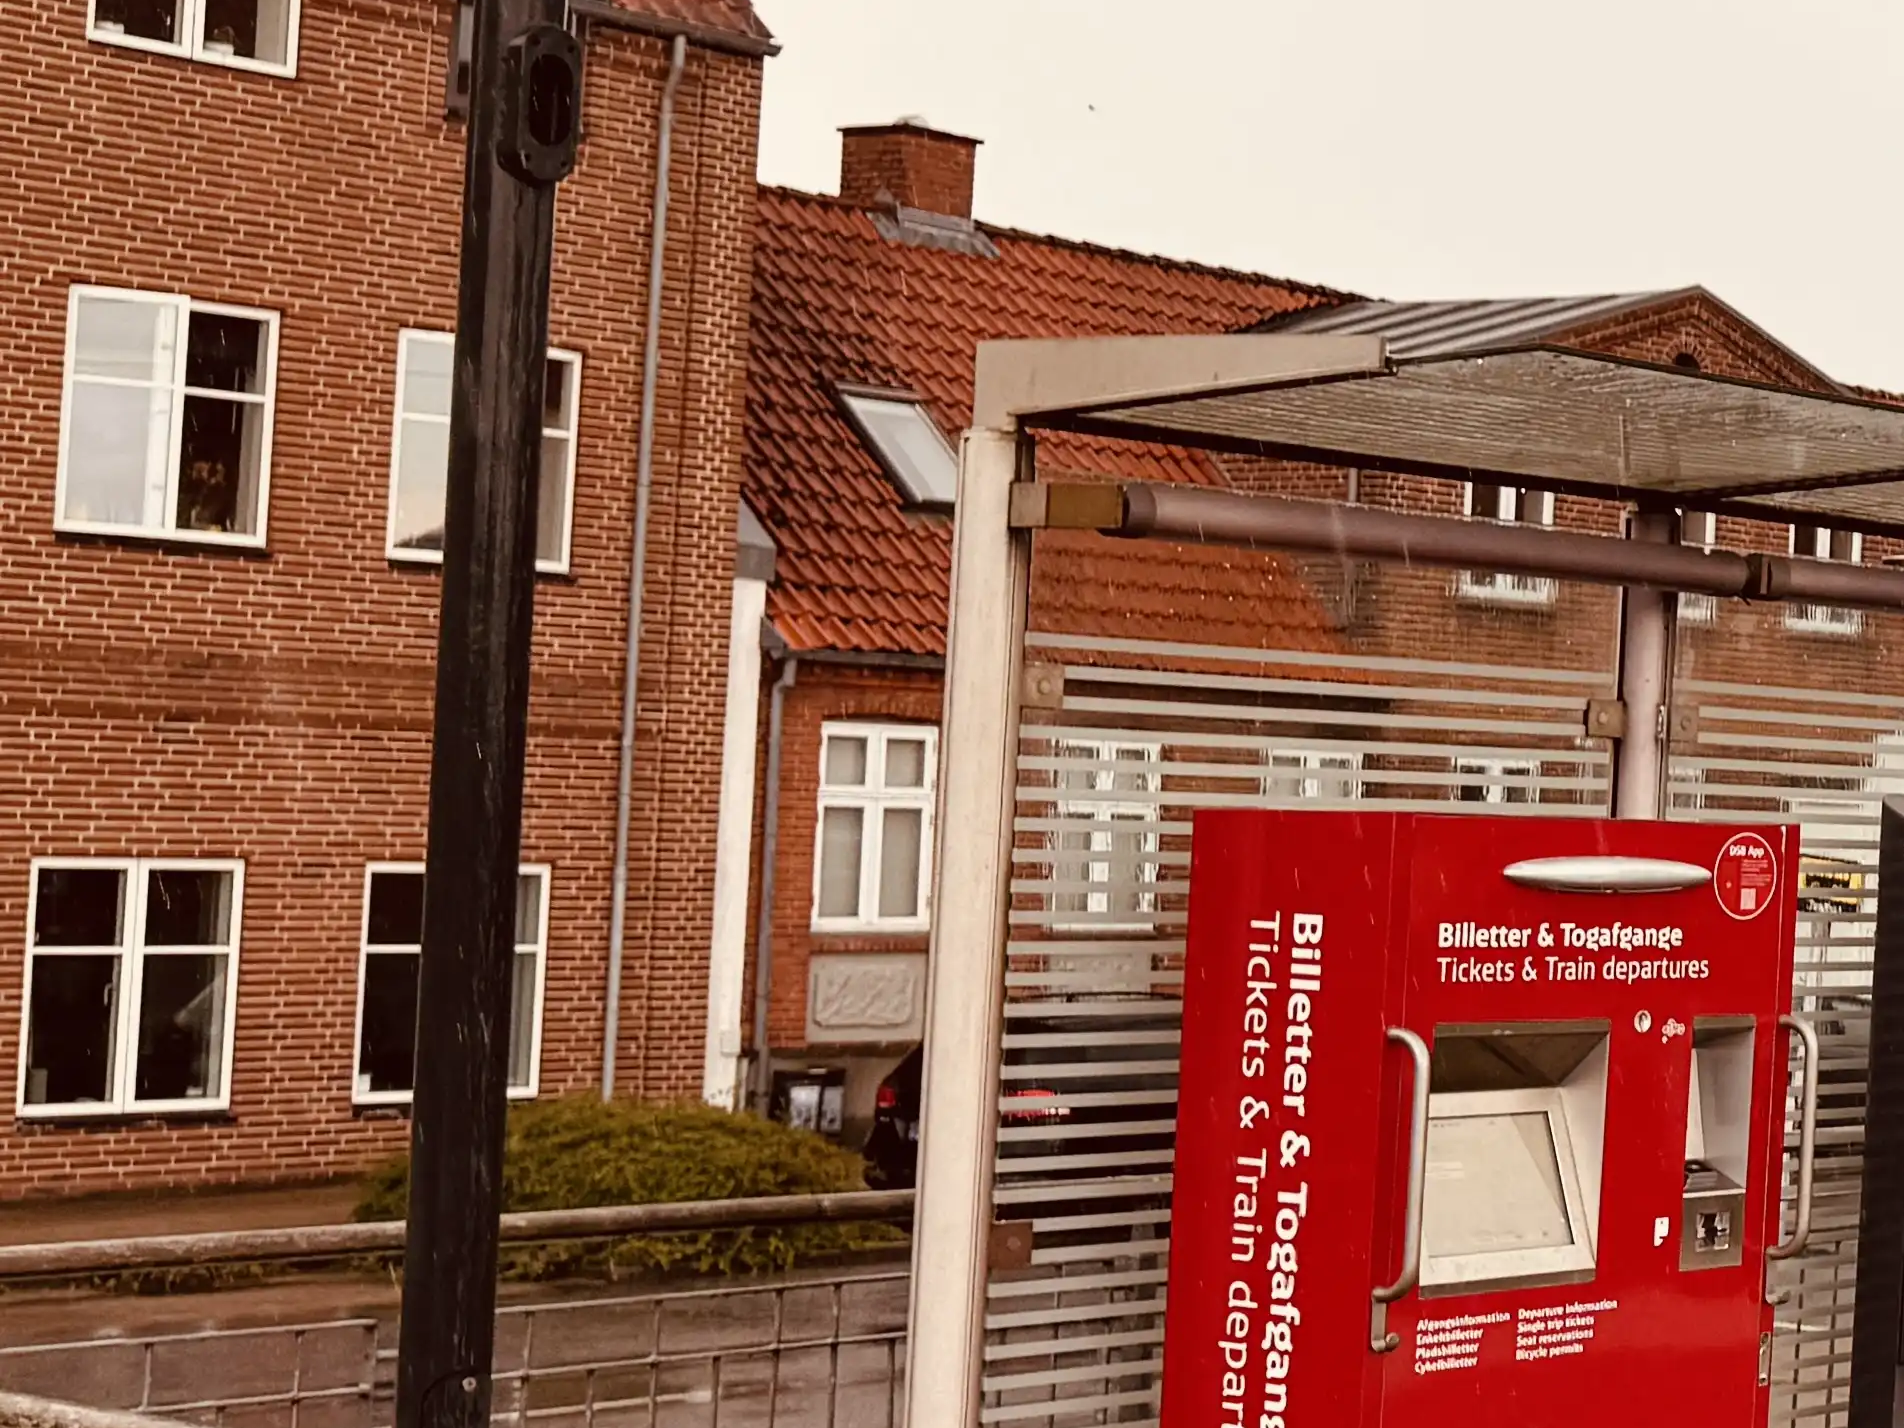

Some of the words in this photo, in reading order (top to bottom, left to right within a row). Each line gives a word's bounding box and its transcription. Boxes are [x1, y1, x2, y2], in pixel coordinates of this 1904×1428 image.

[1439, 922, 1531, 947] Billetter
[1538, 923, 1554, 947] &
[1560, 922, 1682, 951] Togafgange
[1437, 957, 1514, 982] Tickets
[1522, 957, 1537, 981] &
[1545, 956, 1595, 980] Train
[1603, 956, 1708, 984] departures
[1243, 911, 1280, 1077] Tickets
[1284, 914, 1323, 1116] Billetter
[1240, 1096, 1269, 1128] &
[1280, 1131, 1310, 1167] &
[1232, 1148, 1266, 1261] Train
